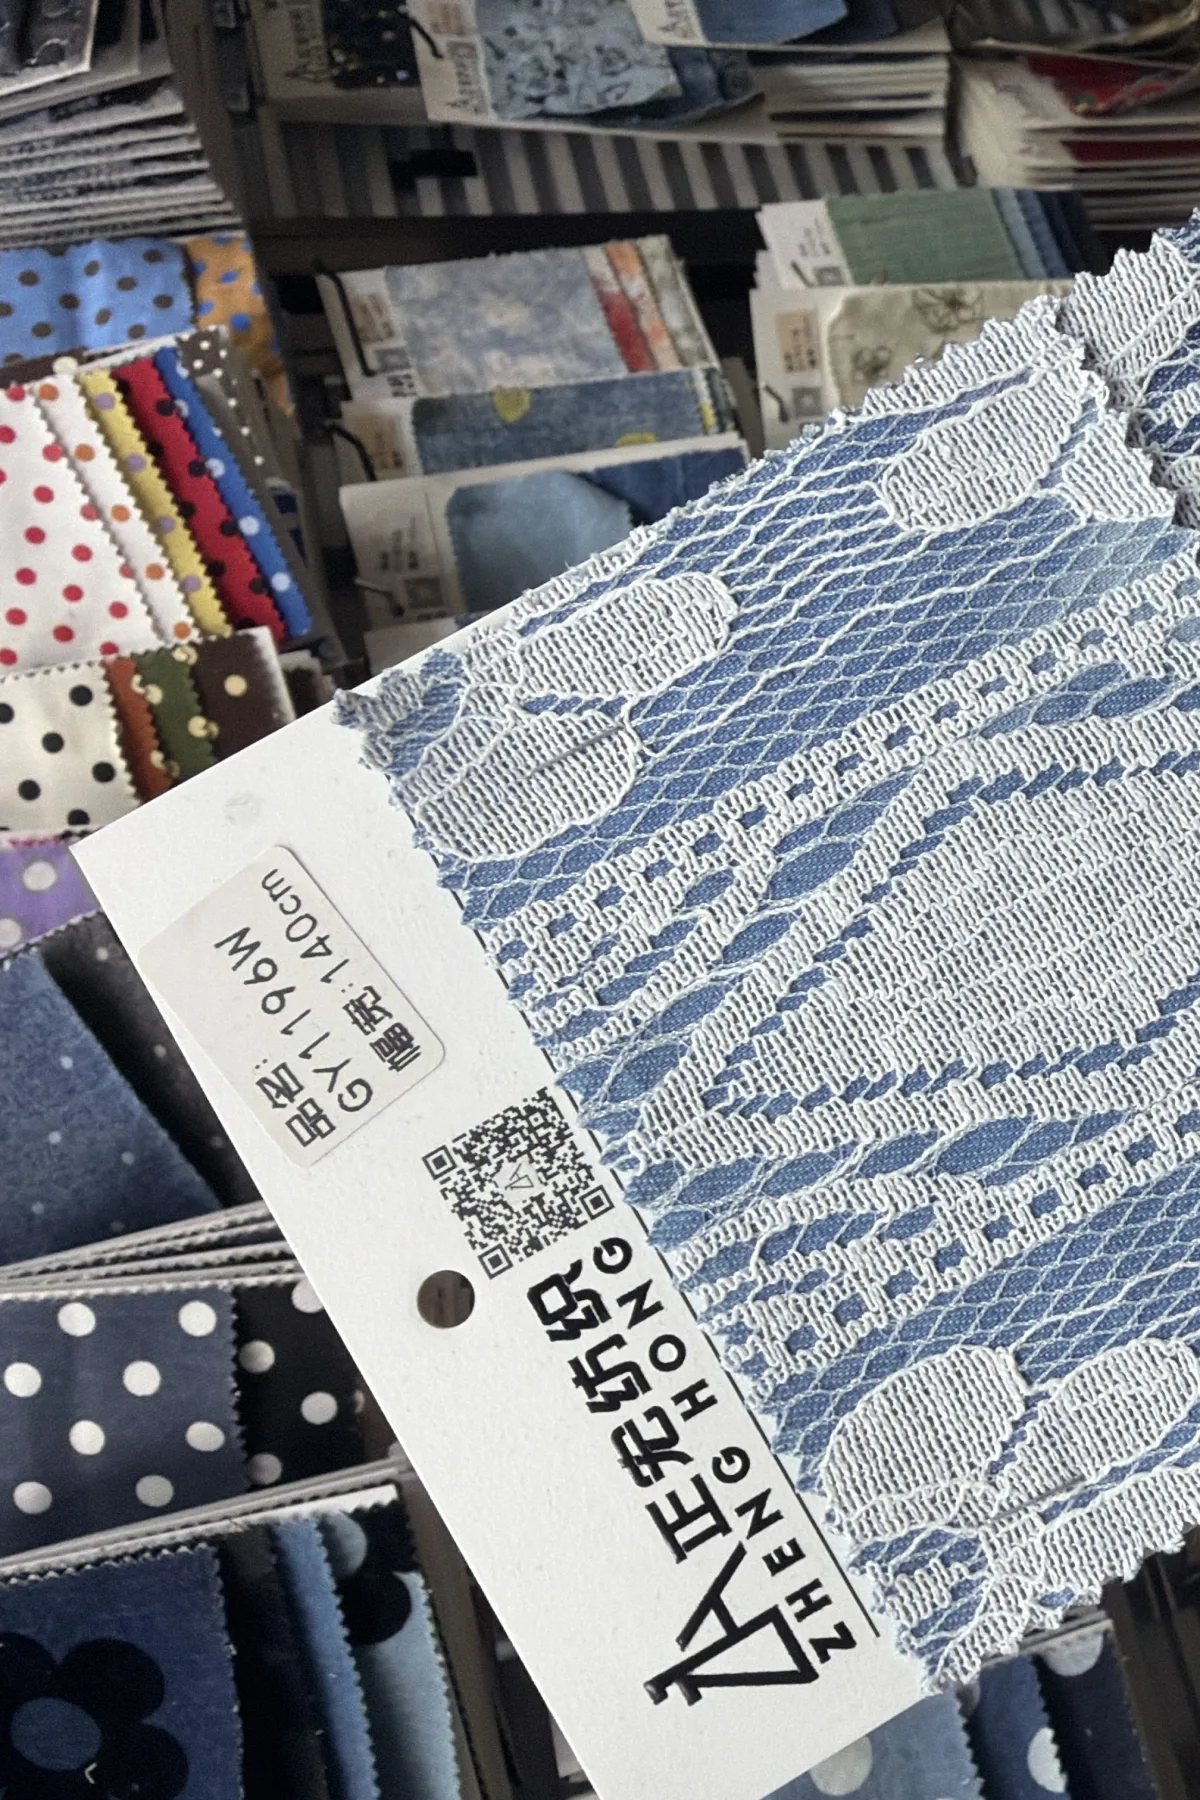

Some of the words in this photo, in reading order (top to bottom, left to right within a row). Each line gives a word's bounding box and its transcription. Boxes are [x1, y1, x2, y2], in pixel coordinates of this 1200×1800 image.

[214, 926, 373, 1113] GY1196W
[527, 1259, 732, 1564] 正宏纺织
[593, 1237, 718, 1421] HONG
[712, 1446, 857, 1664] ZHENG
